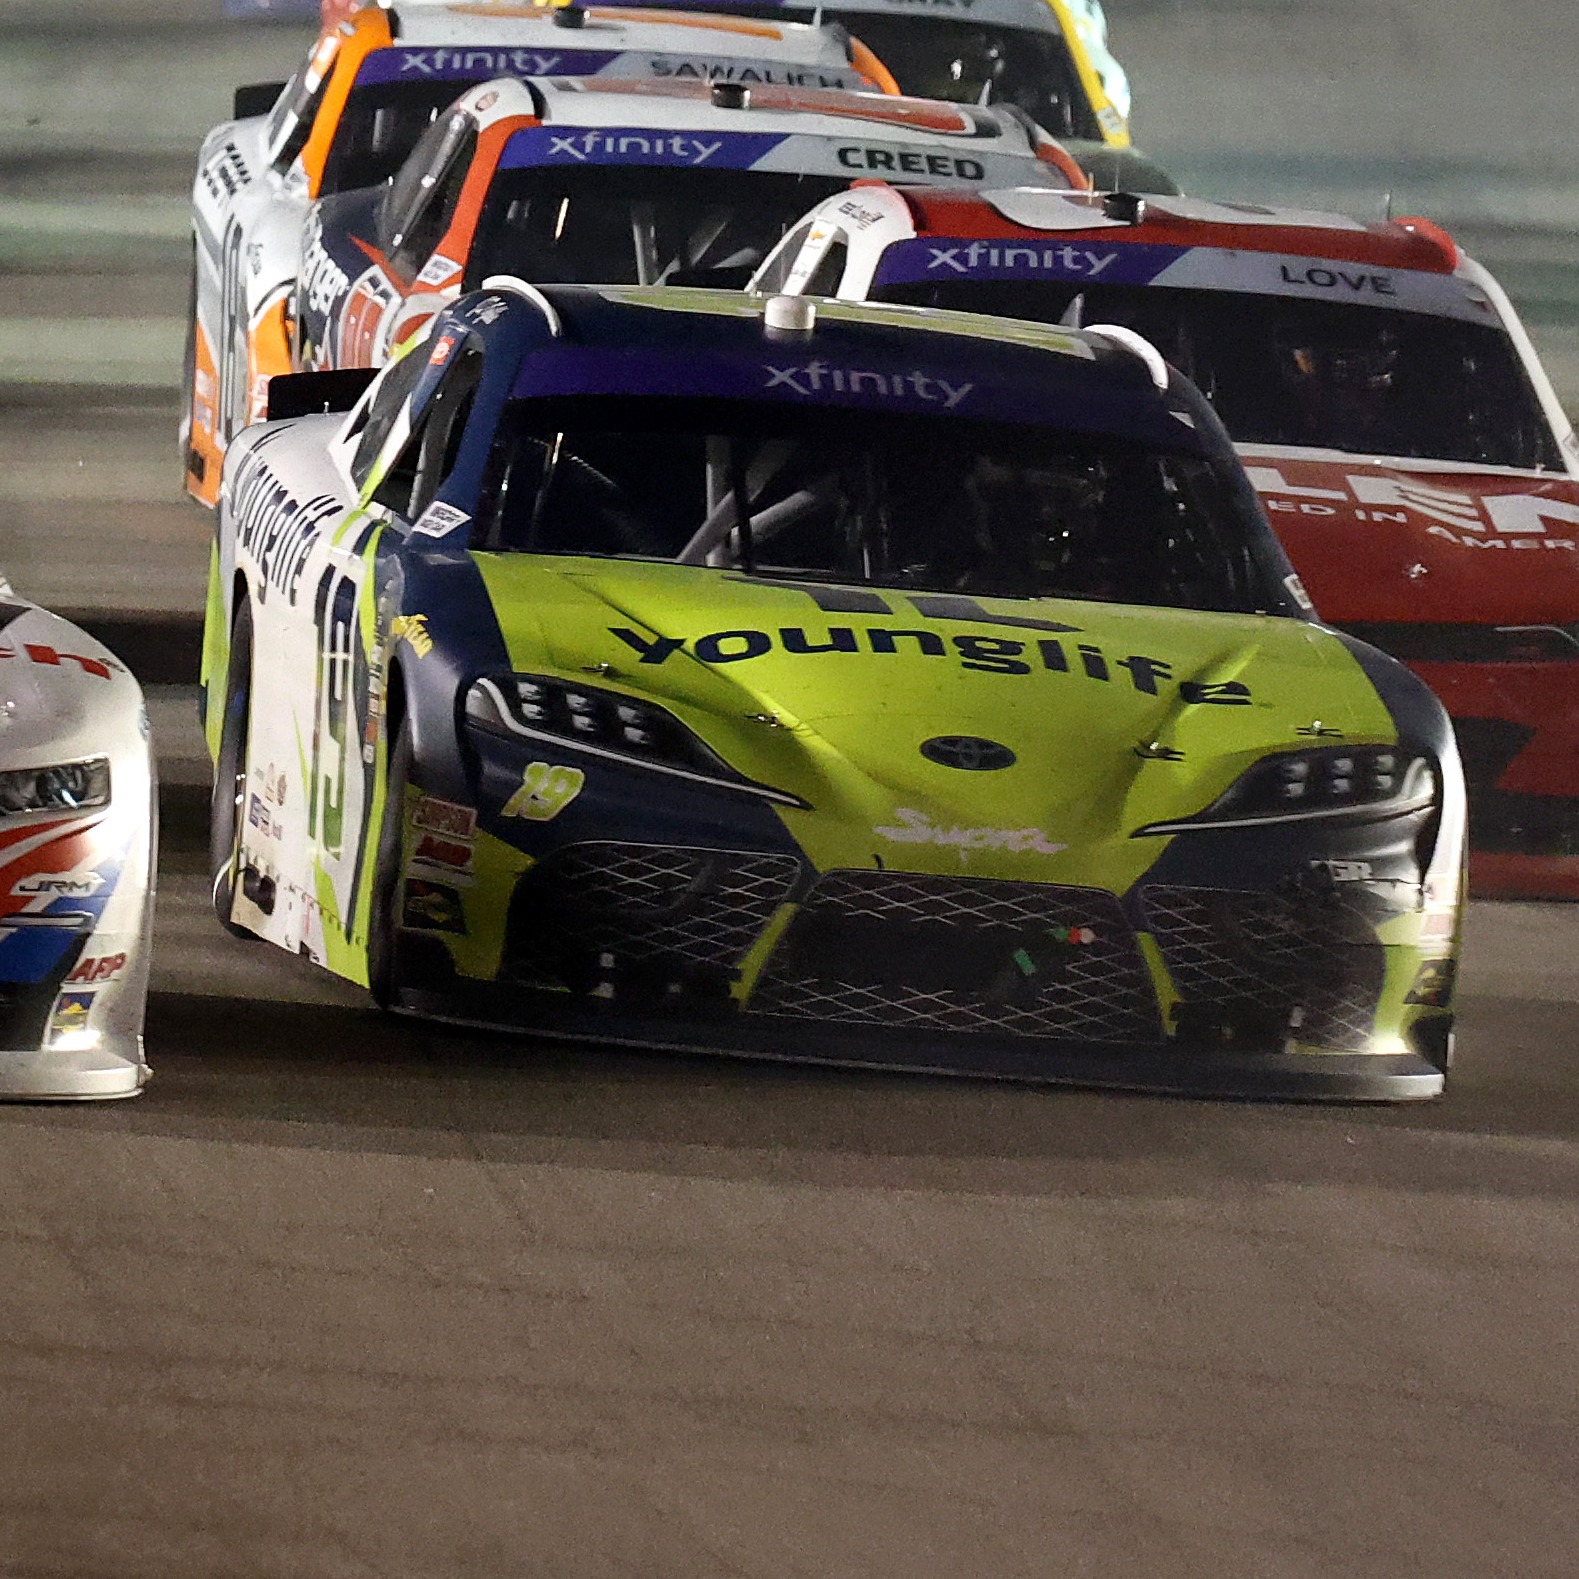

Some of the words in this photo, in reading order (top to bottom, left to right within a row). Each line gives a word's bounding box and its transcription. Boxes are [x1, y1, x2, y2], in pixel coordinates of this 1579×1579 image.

[399, 48, 561, 76] xfinity
[548, 130, 723, 164] xfinity
[837, 146, 984, 181] CREED
[926, 240, 1118, 276] xfinity
[1279, 263, 1398, 296] LOVE
[763, 361, 974, 408] xfinity
[608, 626, 1252, 708] younglife
[501, 760, 586, 821] 19
